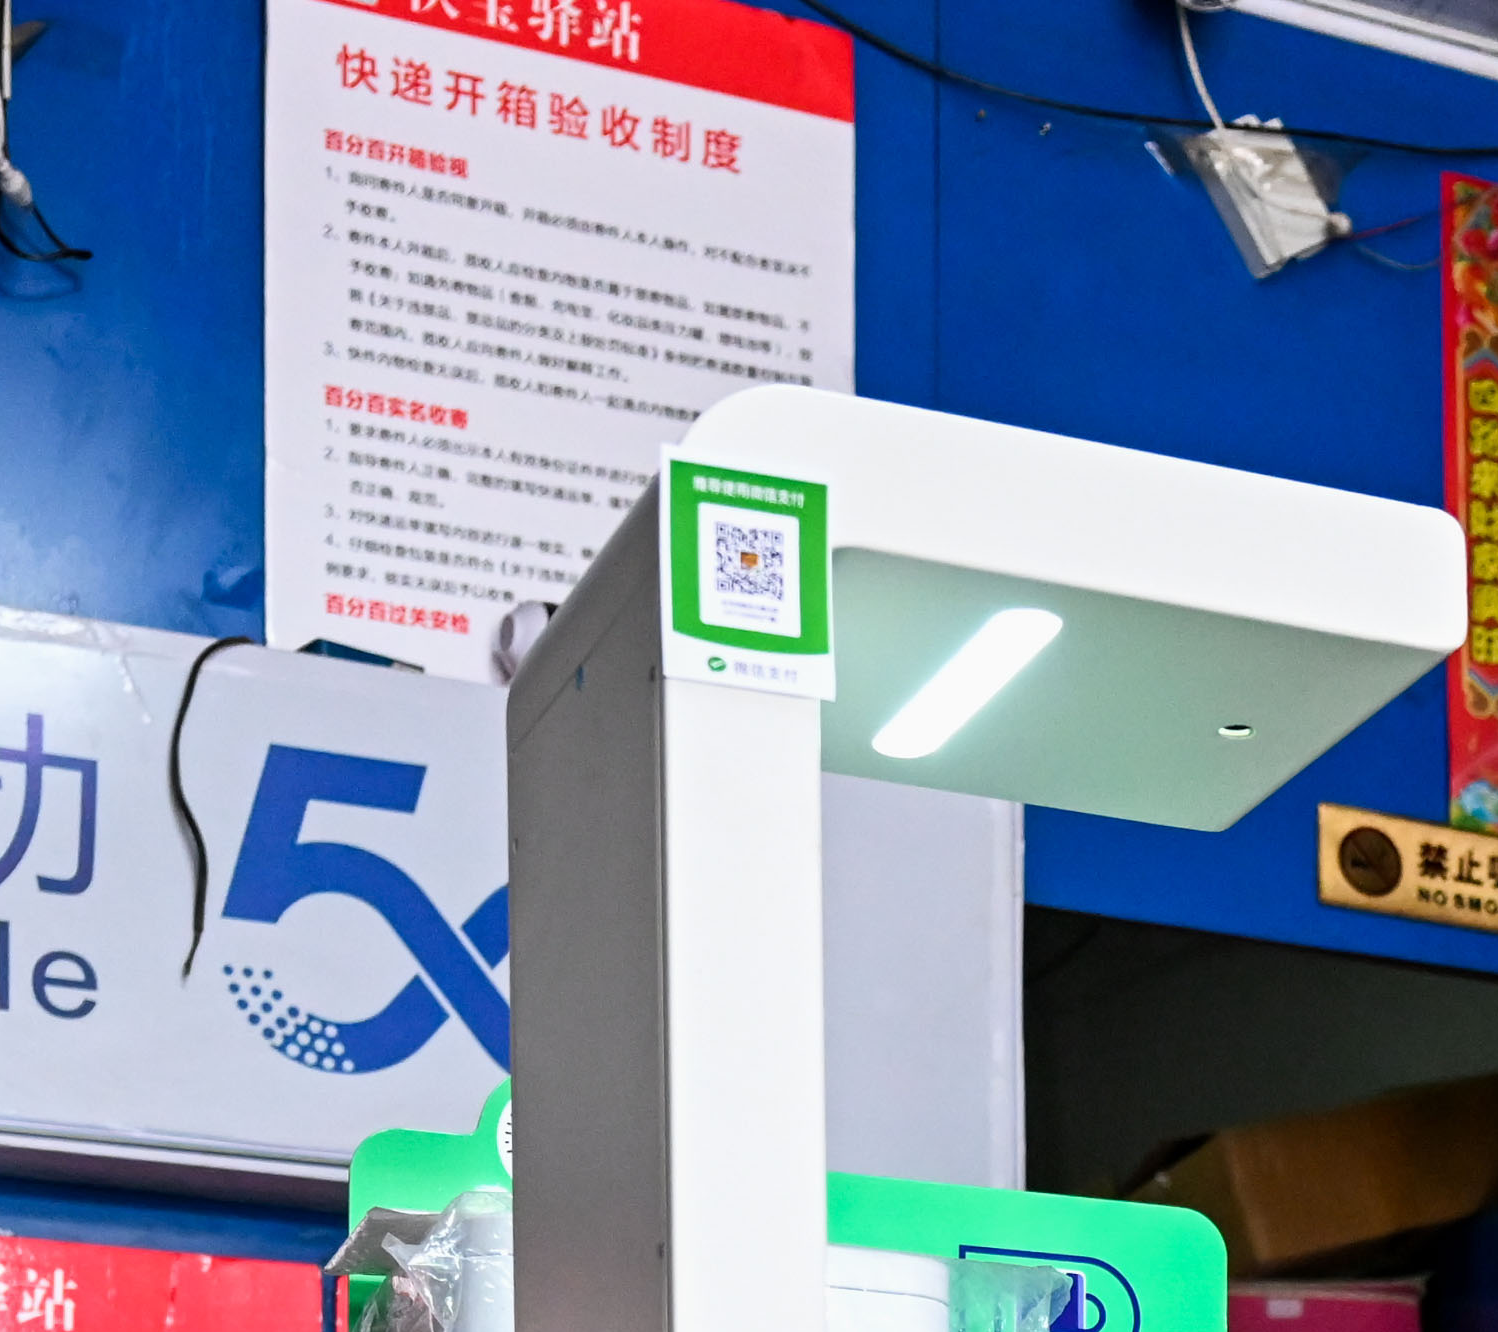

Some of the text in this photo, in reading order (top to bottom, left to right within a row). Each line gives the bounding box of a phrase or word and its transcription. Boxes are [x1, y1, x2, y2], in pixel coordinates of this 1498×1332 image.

[336, 42, 743, 175] 快递开箱验收制度
[323, 128, 469, 179] 百分百开箱验视
[323, 384, 469, 430] 百分百实名收寄
[325, 593, 470, 635] 百分百过关安检
[1417, 887, 1448, 906] NO
